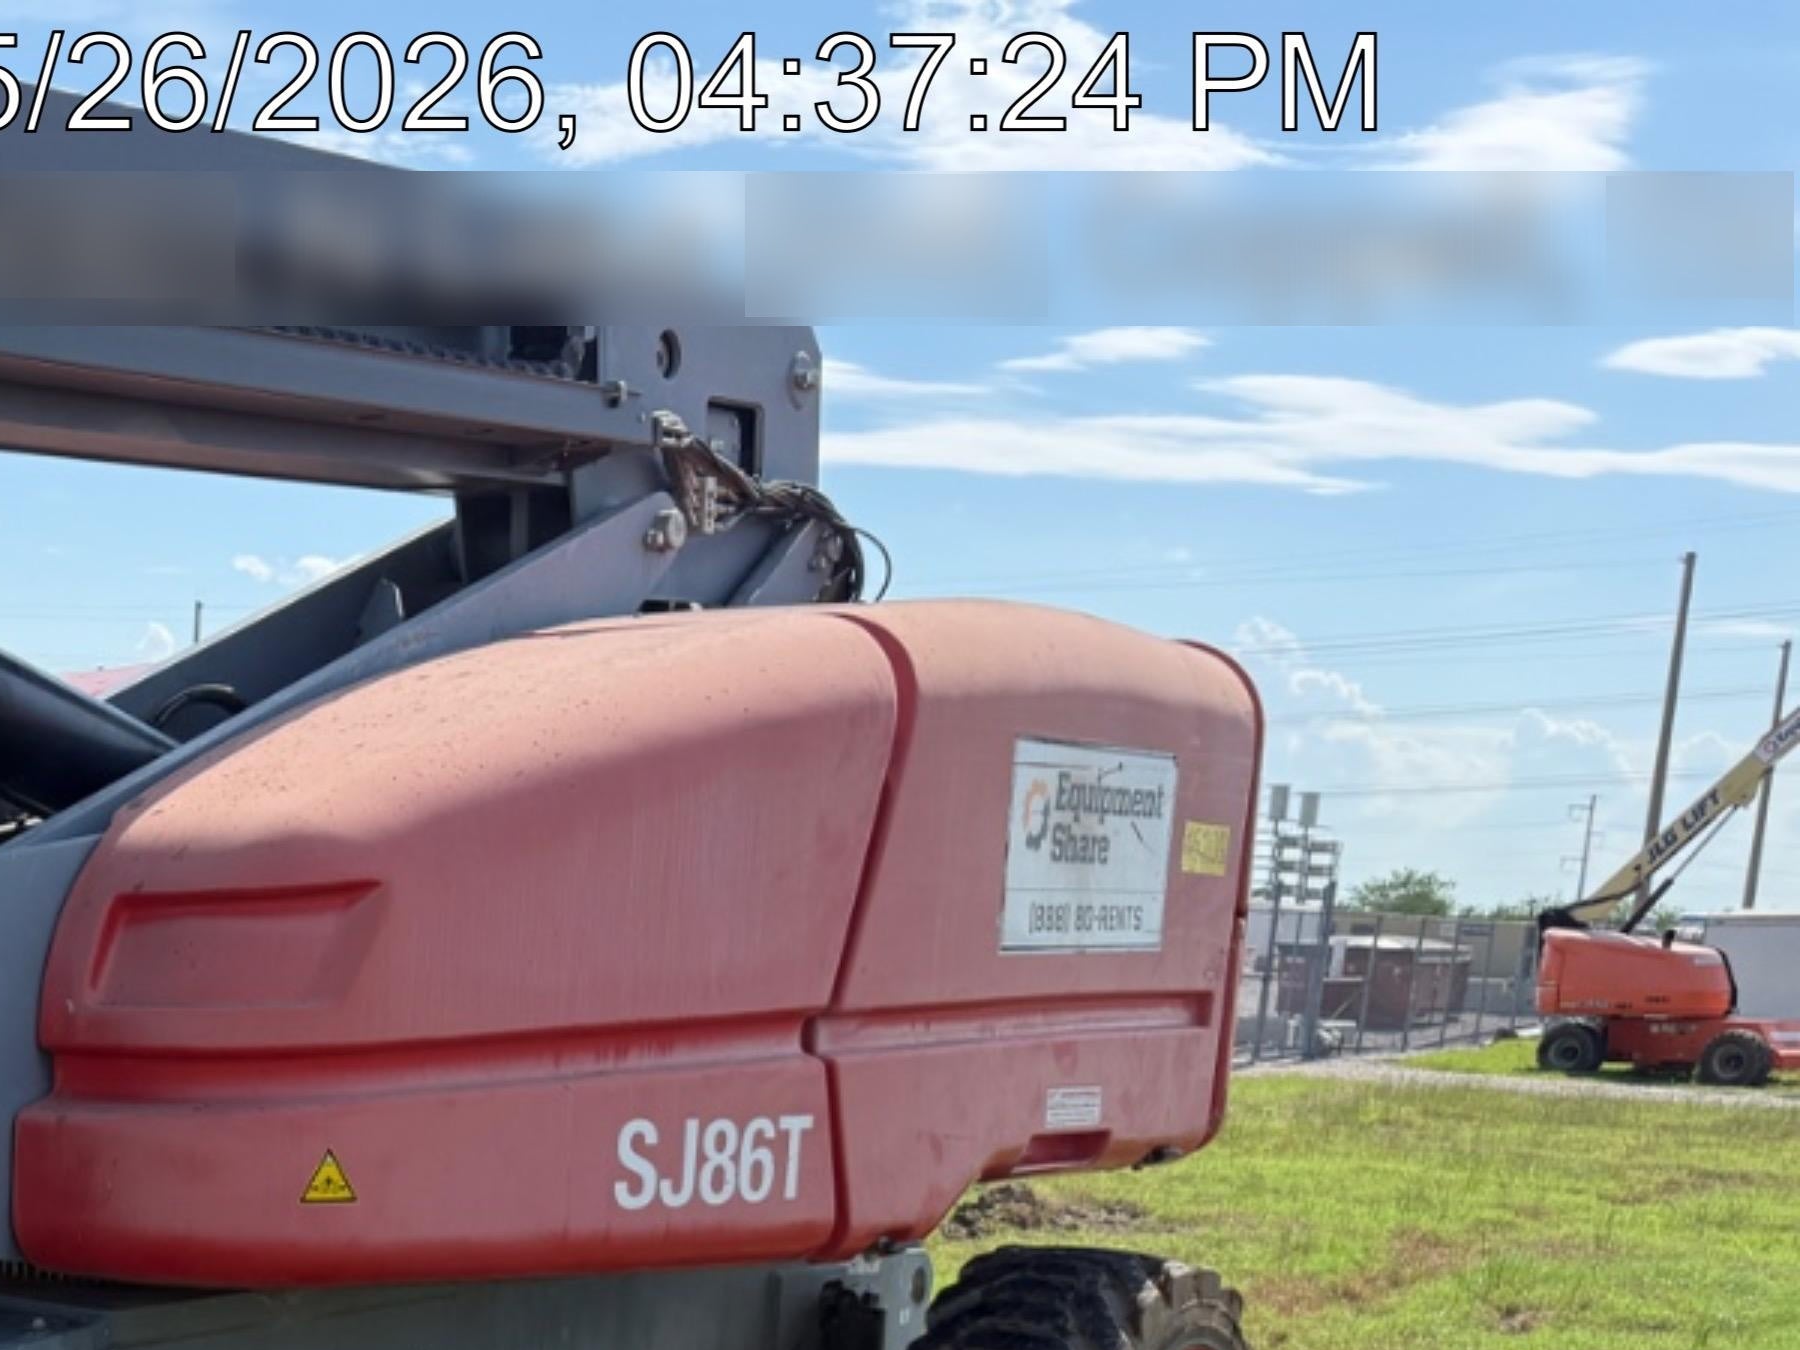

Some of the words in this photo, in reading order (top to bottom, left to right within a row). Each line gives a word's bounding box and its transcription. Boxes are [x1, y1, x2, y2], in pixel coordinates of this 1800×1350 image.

[1055, 771, 1165, 824] Equipment
[1648, 827, 1678, 865] JLG
[1682, 787, 1720, 832] LIFT
[1051, 822, 1111, 865] Share
[614, 1114, 814, 1210] SJ86T
